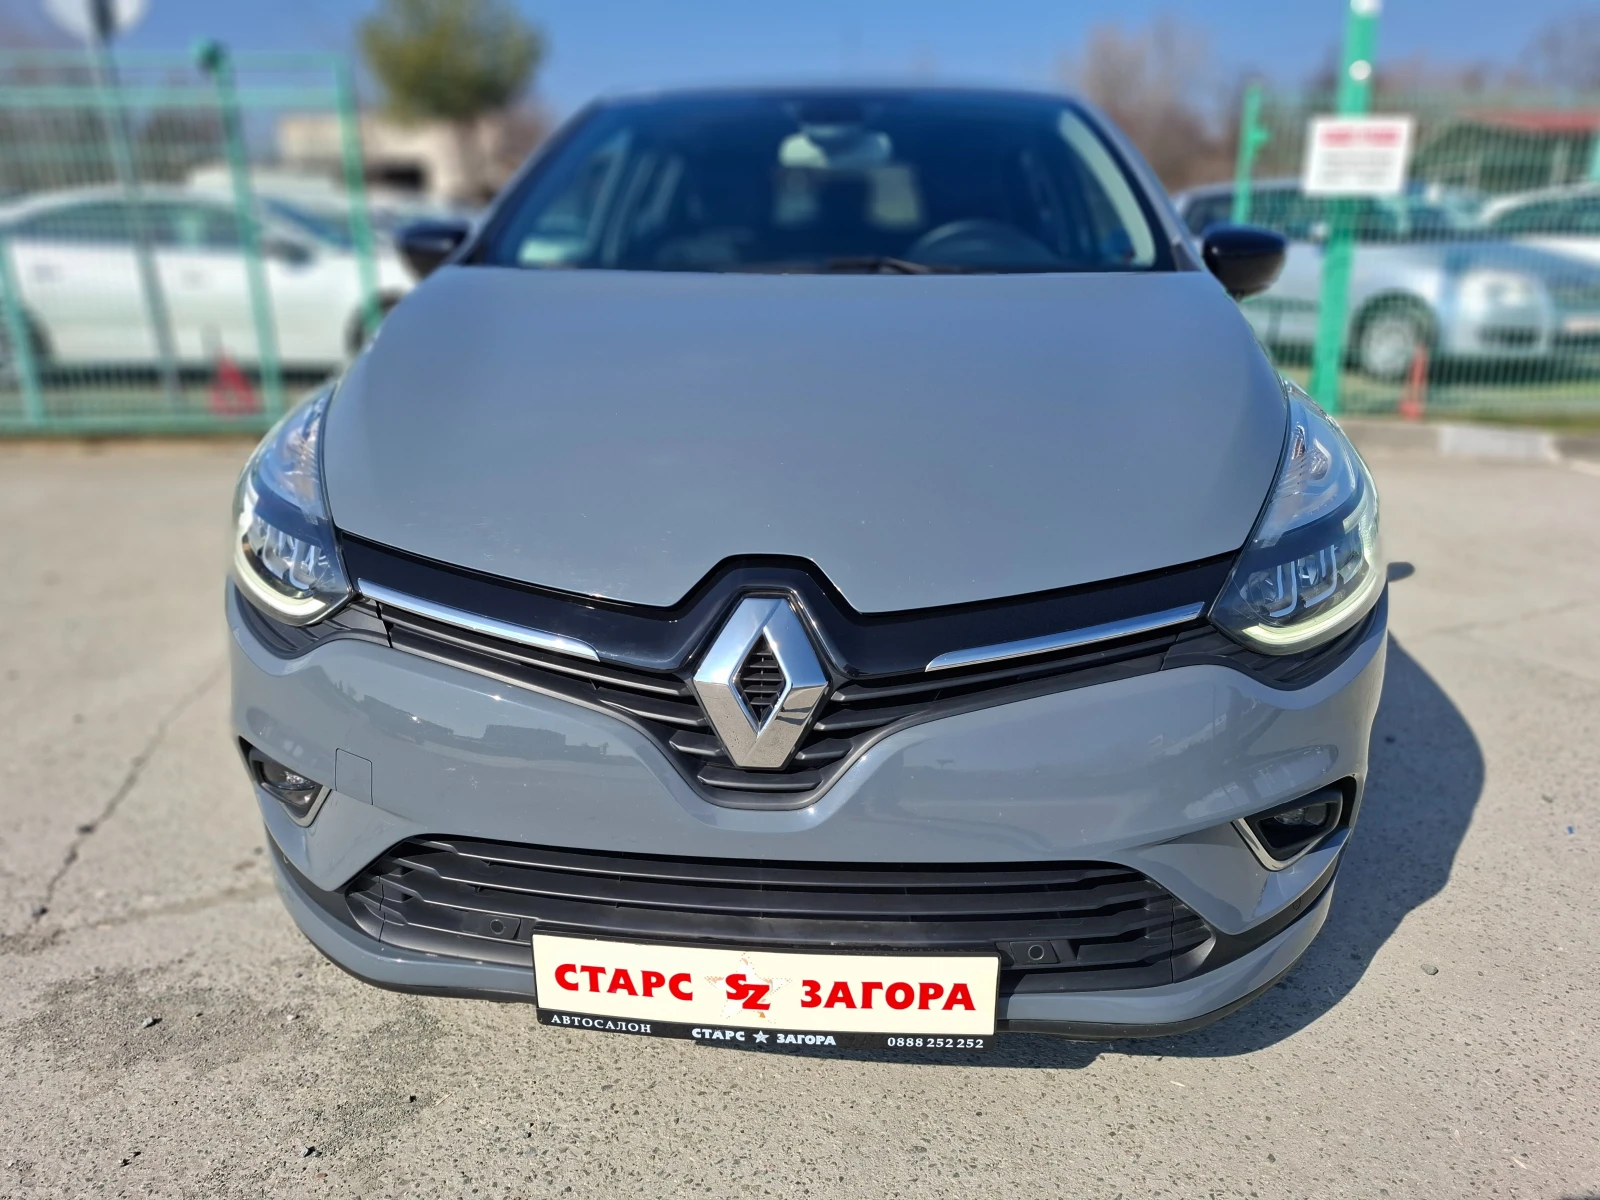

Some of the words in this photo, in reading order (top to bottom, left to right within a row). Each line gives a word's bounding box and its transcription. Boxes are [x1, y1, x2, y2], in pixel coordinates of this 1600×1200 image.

[554, 963, 693, 1001] СТАРС
[725, 973, 771, 1011] SZ
[800, 979, 976, 1011] ЗАГОРА
[551, 1014, 652, 1034] АВТОСАЛОН
[691, 1027, 746, 1042] СТАРС
[776, 1033, 837, 1046] ЗАГОРА
[887, 1036, 924, 1048] 0888
[926, 1037, 954, 1049] 252
[956, 1038, 984, 1049] 252
